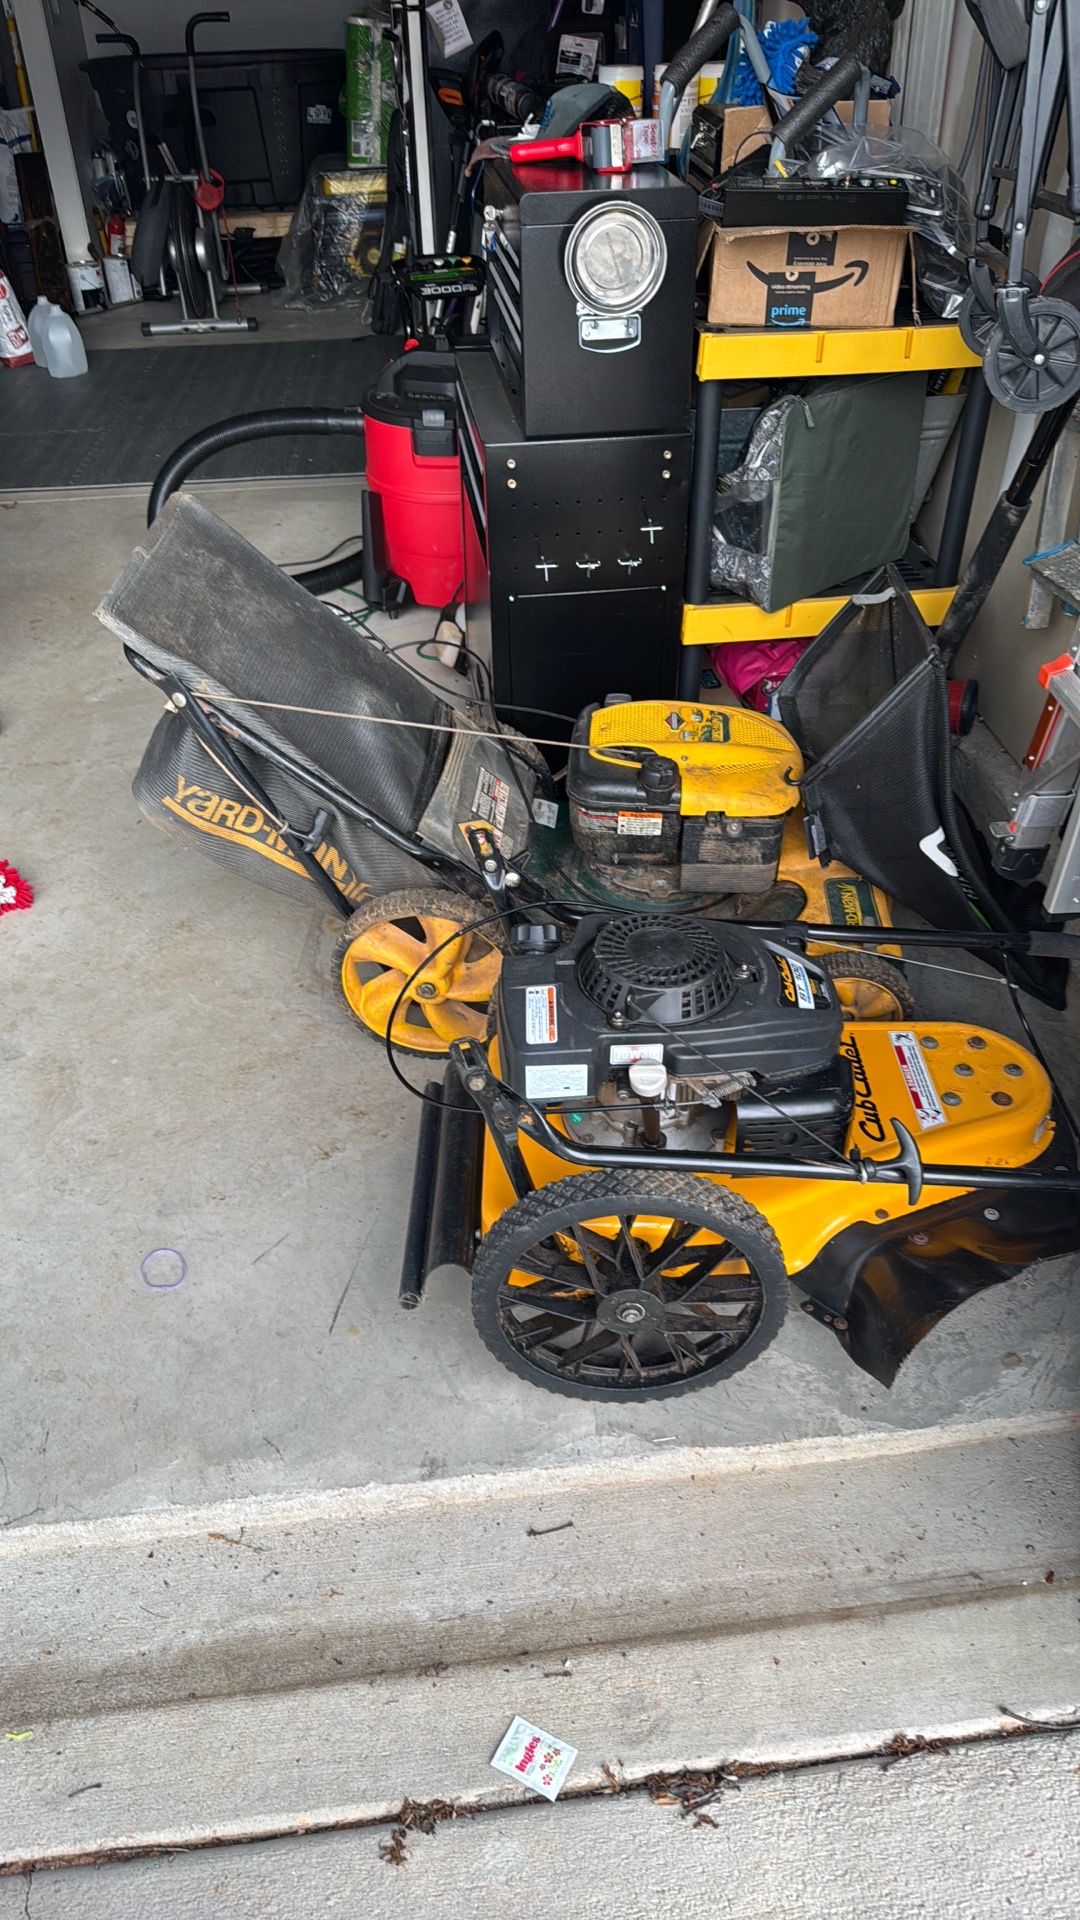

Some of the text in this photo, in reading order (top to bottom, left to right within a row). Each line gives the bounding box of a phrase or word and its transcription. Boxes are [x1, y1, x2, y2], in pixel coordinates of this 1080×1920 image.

[420, 284, 462, 296] 3000
[771, 303, 806, 318] prime
[855, 1100, 886, 1142] Cub
[515, 1735, 541, 1773] Ingles
